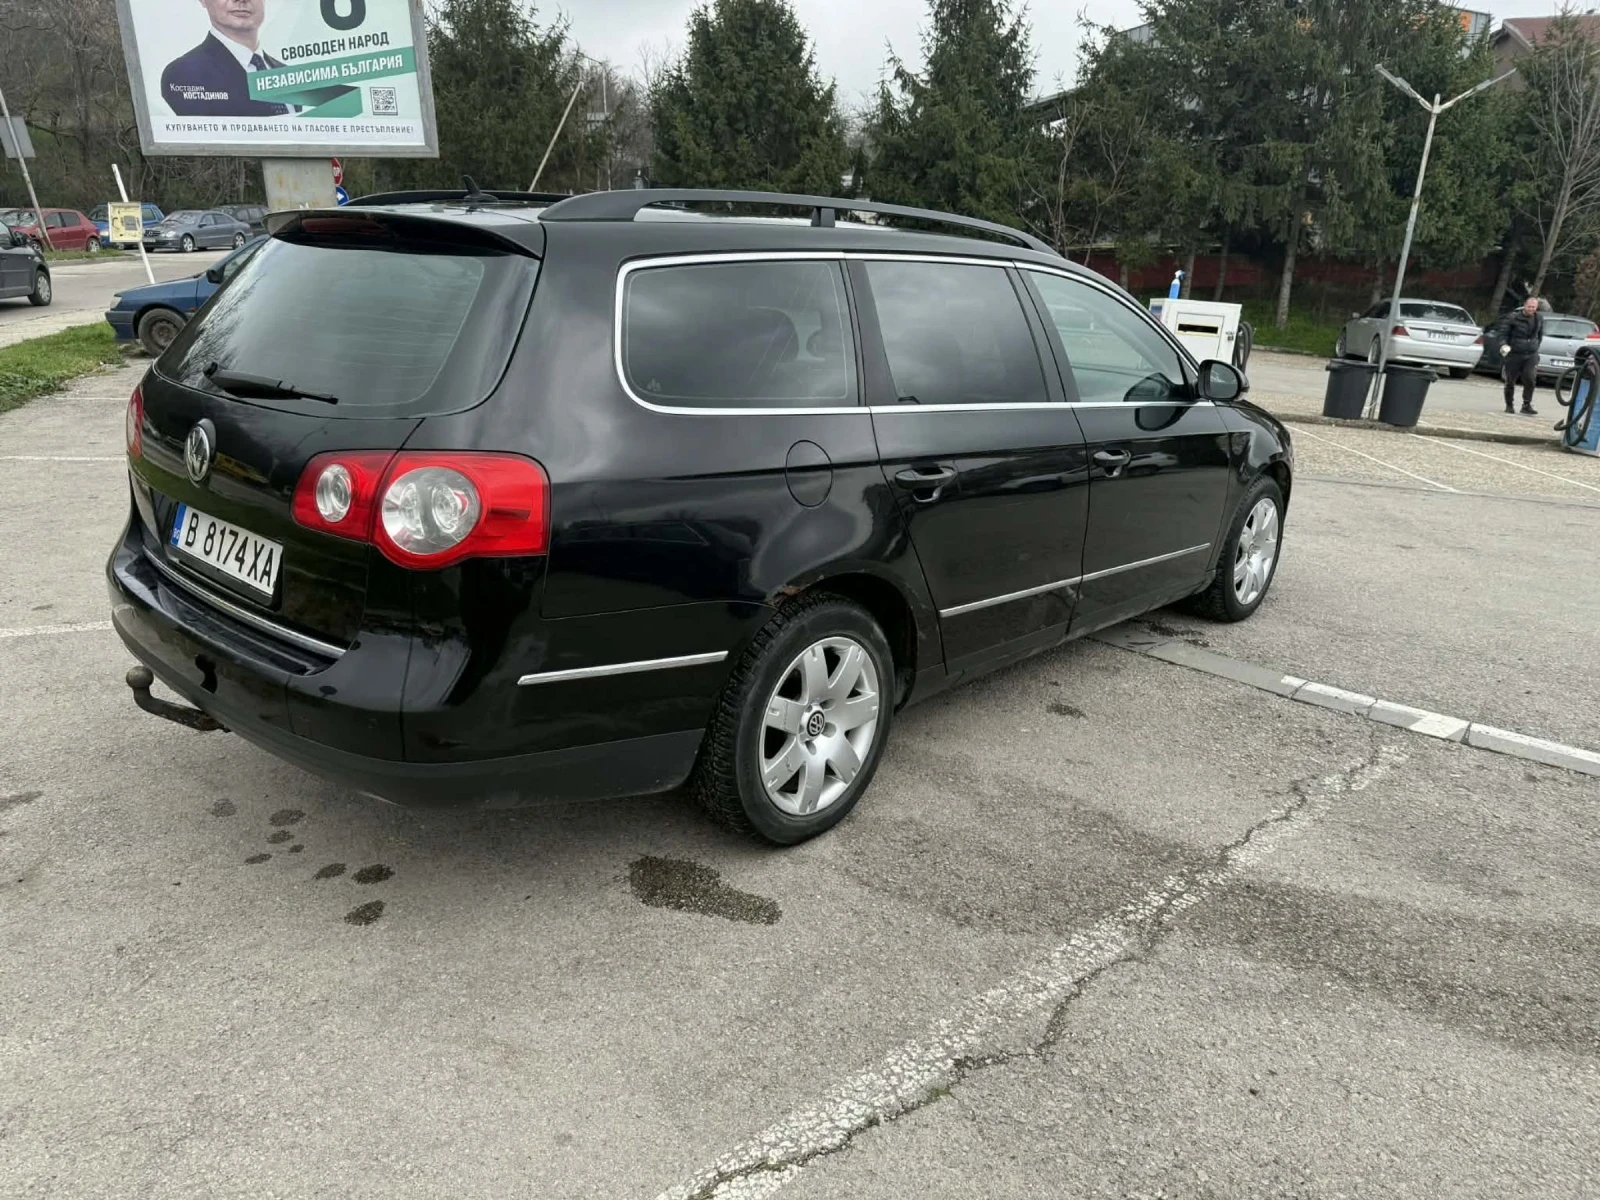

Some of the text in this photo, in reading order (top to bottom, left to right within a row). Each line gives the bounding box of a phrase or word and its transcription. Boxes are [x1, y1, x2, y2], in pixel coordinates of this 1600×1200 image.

[281, 31, 390, 61] СВОБОДЕН НАРОД
[256, 54, 403, 91] НЕЗАВИСИМА БЪЛГАРИЯ
[169, 82, 205, 92] Костадин
[182, 91, 229, 101] КОСТАДИНОВ
[165, 123, 414, 134] КУПУВАНЕТО И ПРОДАВАНЕТО НА ГЛАСОВЕ Е ПРЕСТЪПЛЕНИЕ!
[184, 512, 199, 547] B
